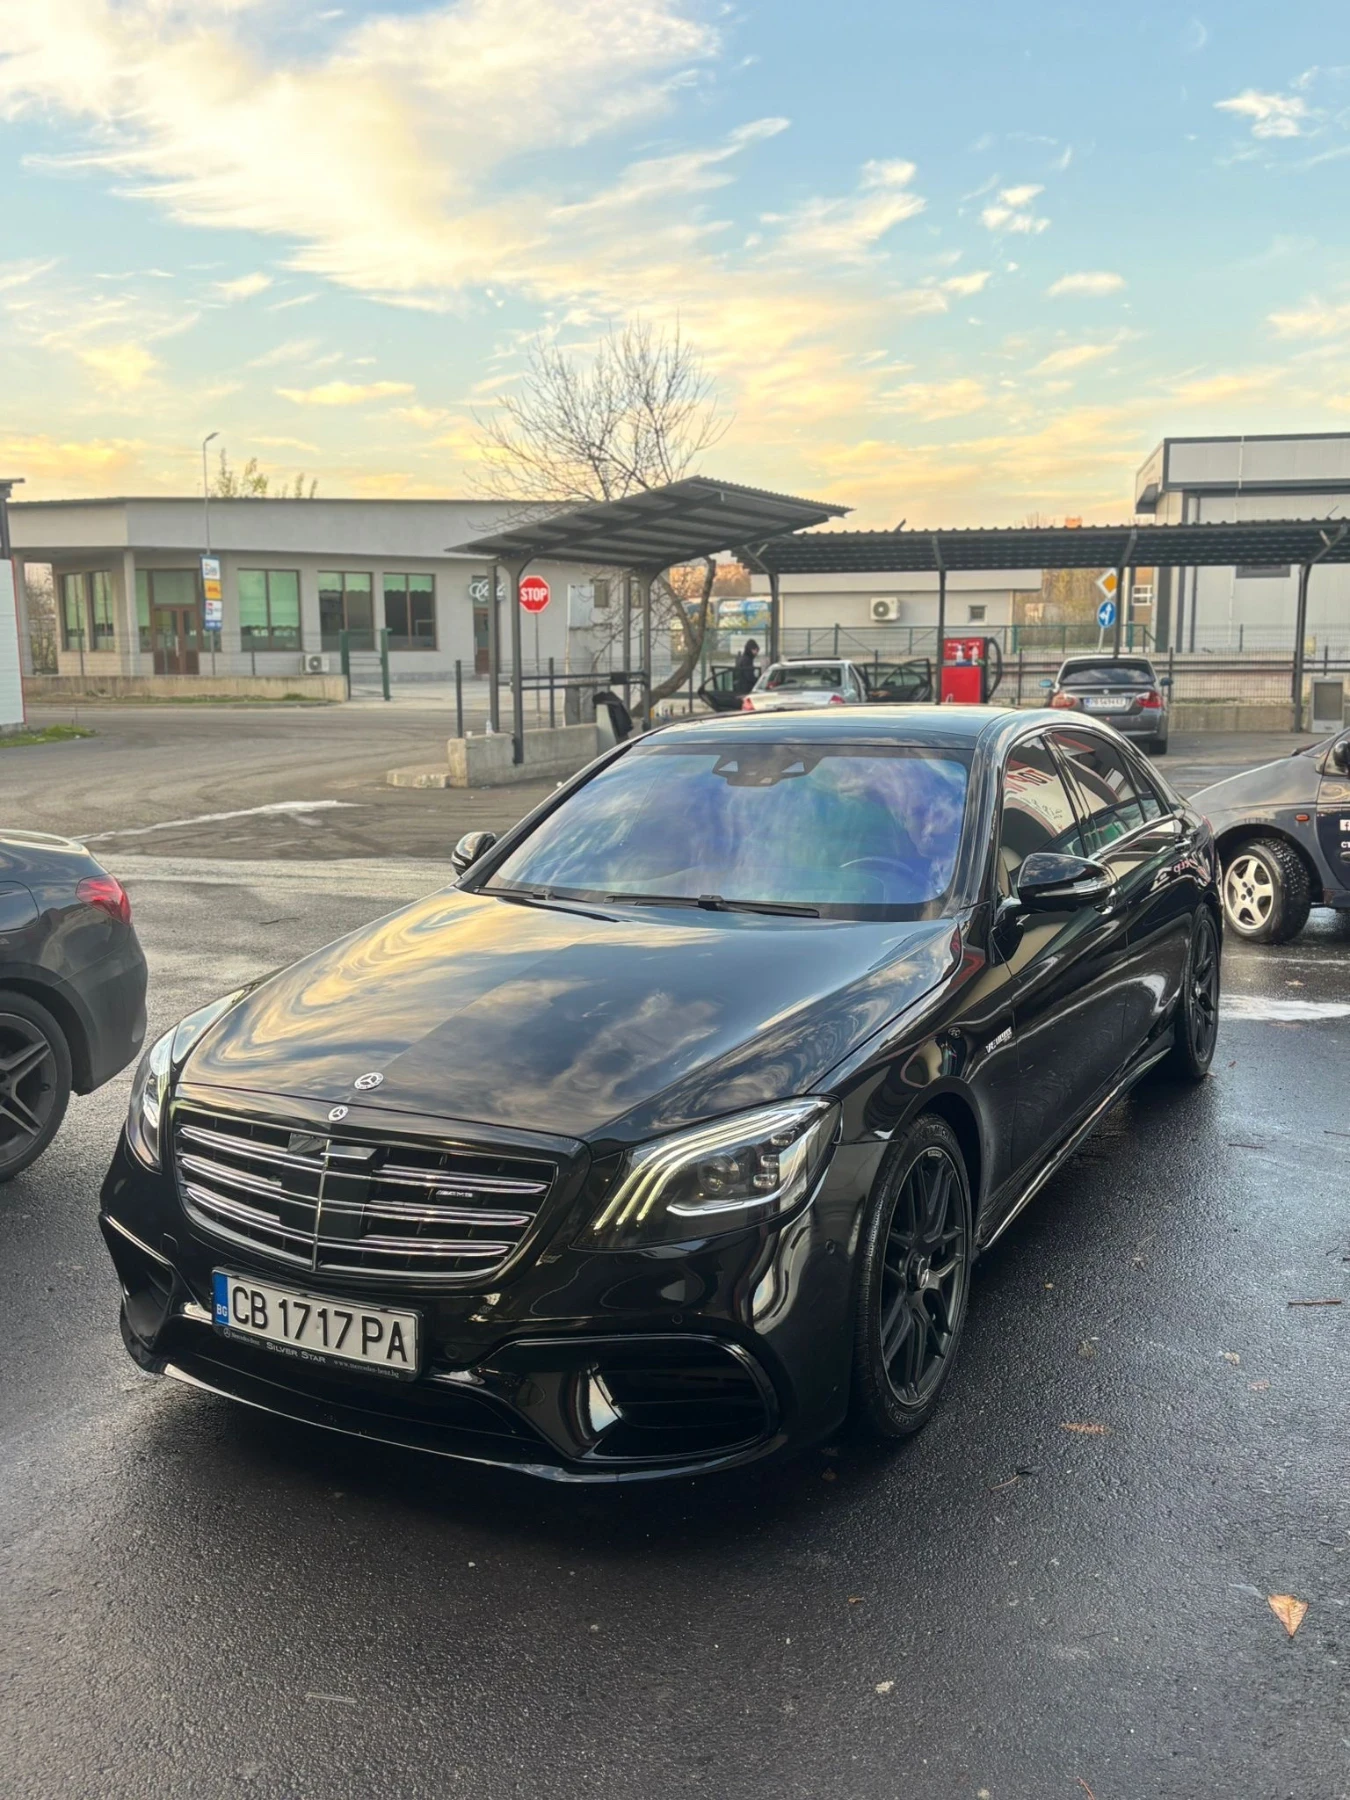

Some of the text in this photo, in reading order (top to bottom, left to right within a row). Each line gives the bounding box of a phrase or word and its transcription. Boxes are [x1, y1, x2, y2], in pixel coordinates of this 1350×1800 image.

[520, 587, 548, 602] STOP
[216, 1303, 228, 1317] BG
[232, 1285, 408, 1363] CB 1717 PA
